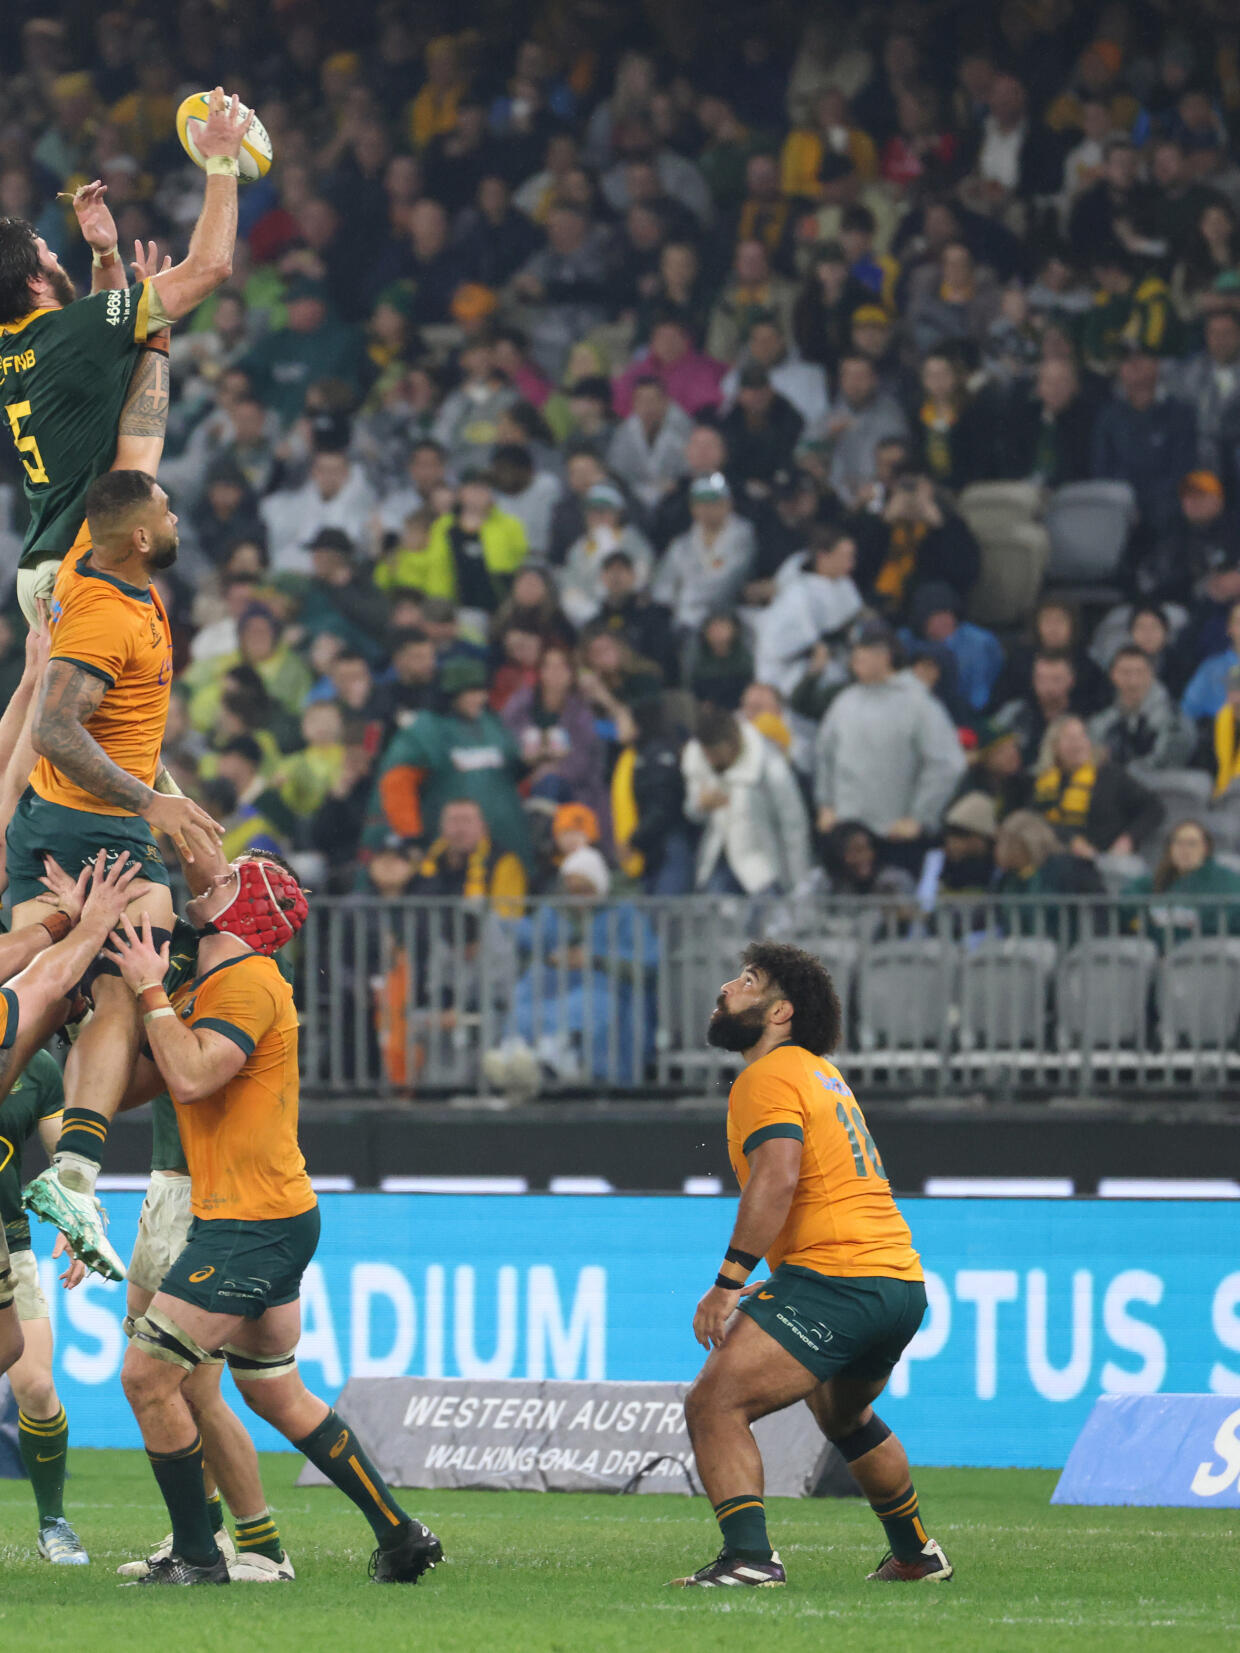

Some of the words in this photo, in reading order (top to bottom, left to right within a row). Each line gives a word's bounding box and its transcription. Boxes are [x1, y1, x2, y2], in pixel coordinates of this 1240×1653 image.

[2, 349, 36, 376] FNB
[5, 400, 49, 484] 5
[295, 1261, 609, 1388] ADIUM
[776, 1312, 820, 1352] DEFENDER
[888, 1267, 1168, 1402] PTUS
[402, 1396, 567, 1431] WESTERN
[567, 1399, 688, 1434] AUSTR
[424, 1445, 538, 1472] WALKING
[538, 1447, 580, 1471] ON
[576, 1448, 600, 1472] A
